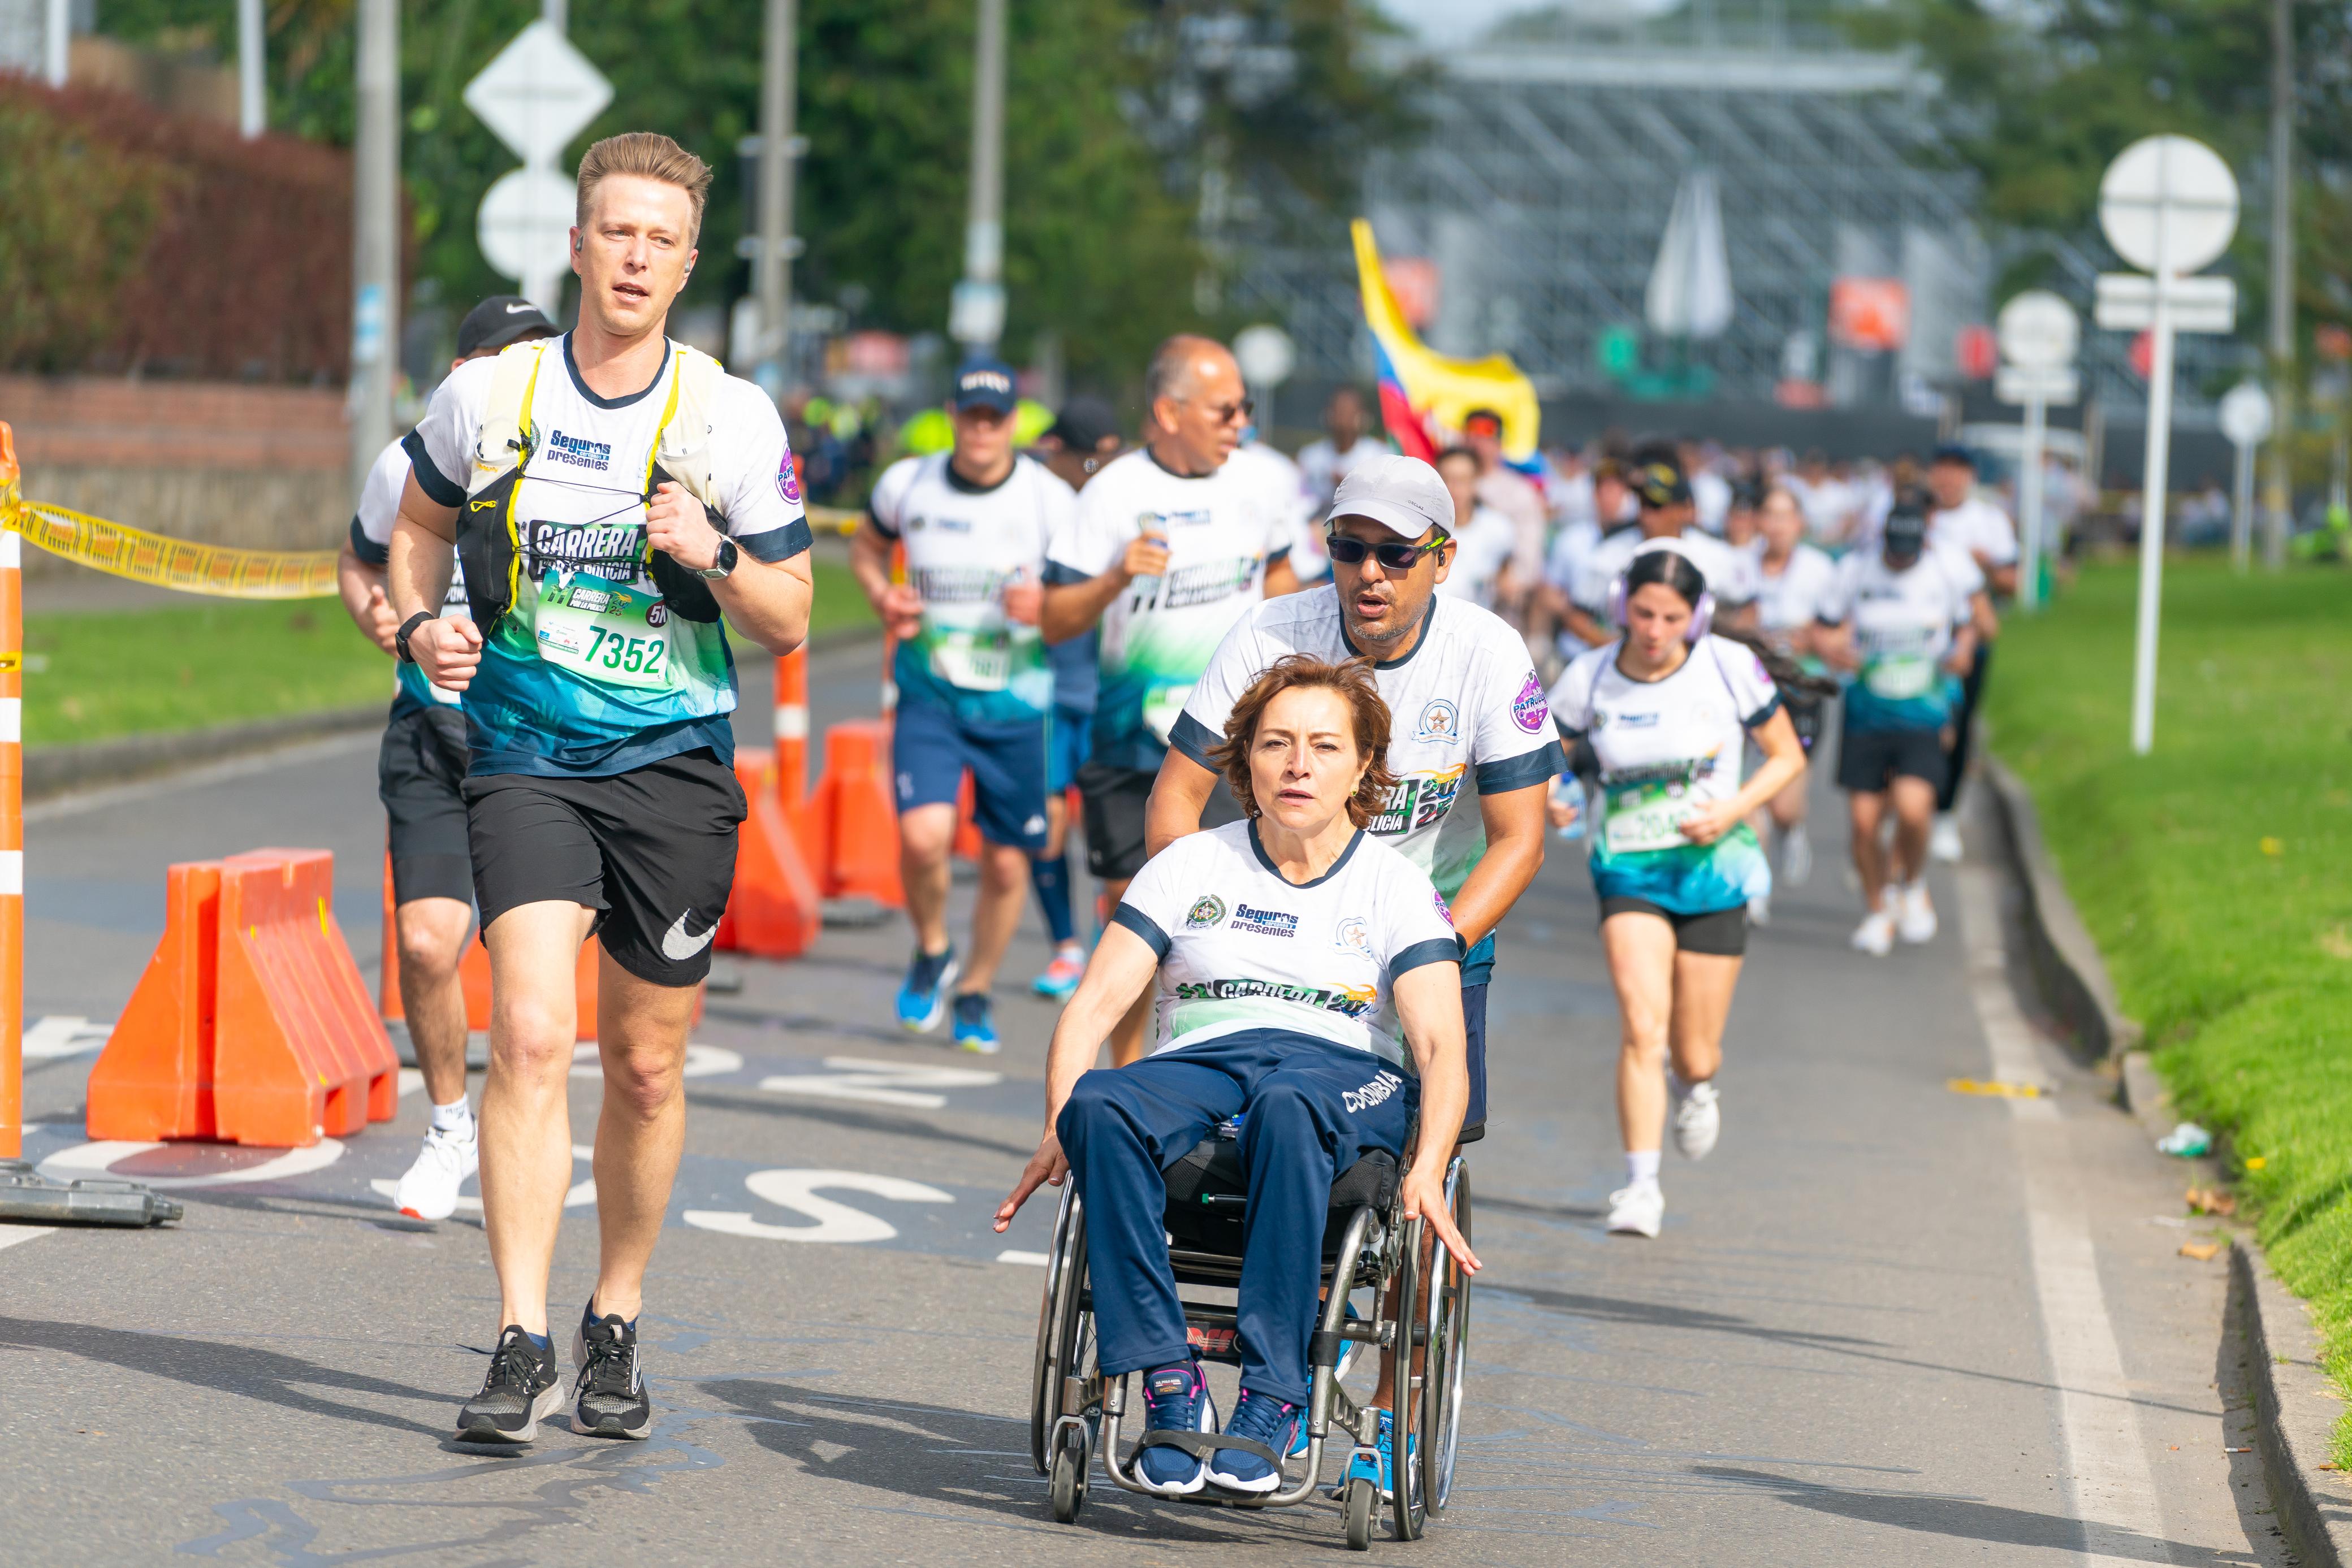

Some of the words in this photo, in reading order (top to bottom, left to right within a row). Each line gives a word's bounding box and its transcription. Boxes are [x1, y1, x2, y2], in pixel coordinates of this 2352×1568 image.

[550, 430, 611, 454] Seguros
[547, 449, 609, 471] presentes
[536, 524, 639, 560] CARRERA
[572, 588, 611, 605] CARRERA
[649, 605, 666, 624] 5K
[585, 625, 665, 674] 7352
[1235, 904, 1299, 924] Seguros
[1230, 920, 1295, 938] presentes
